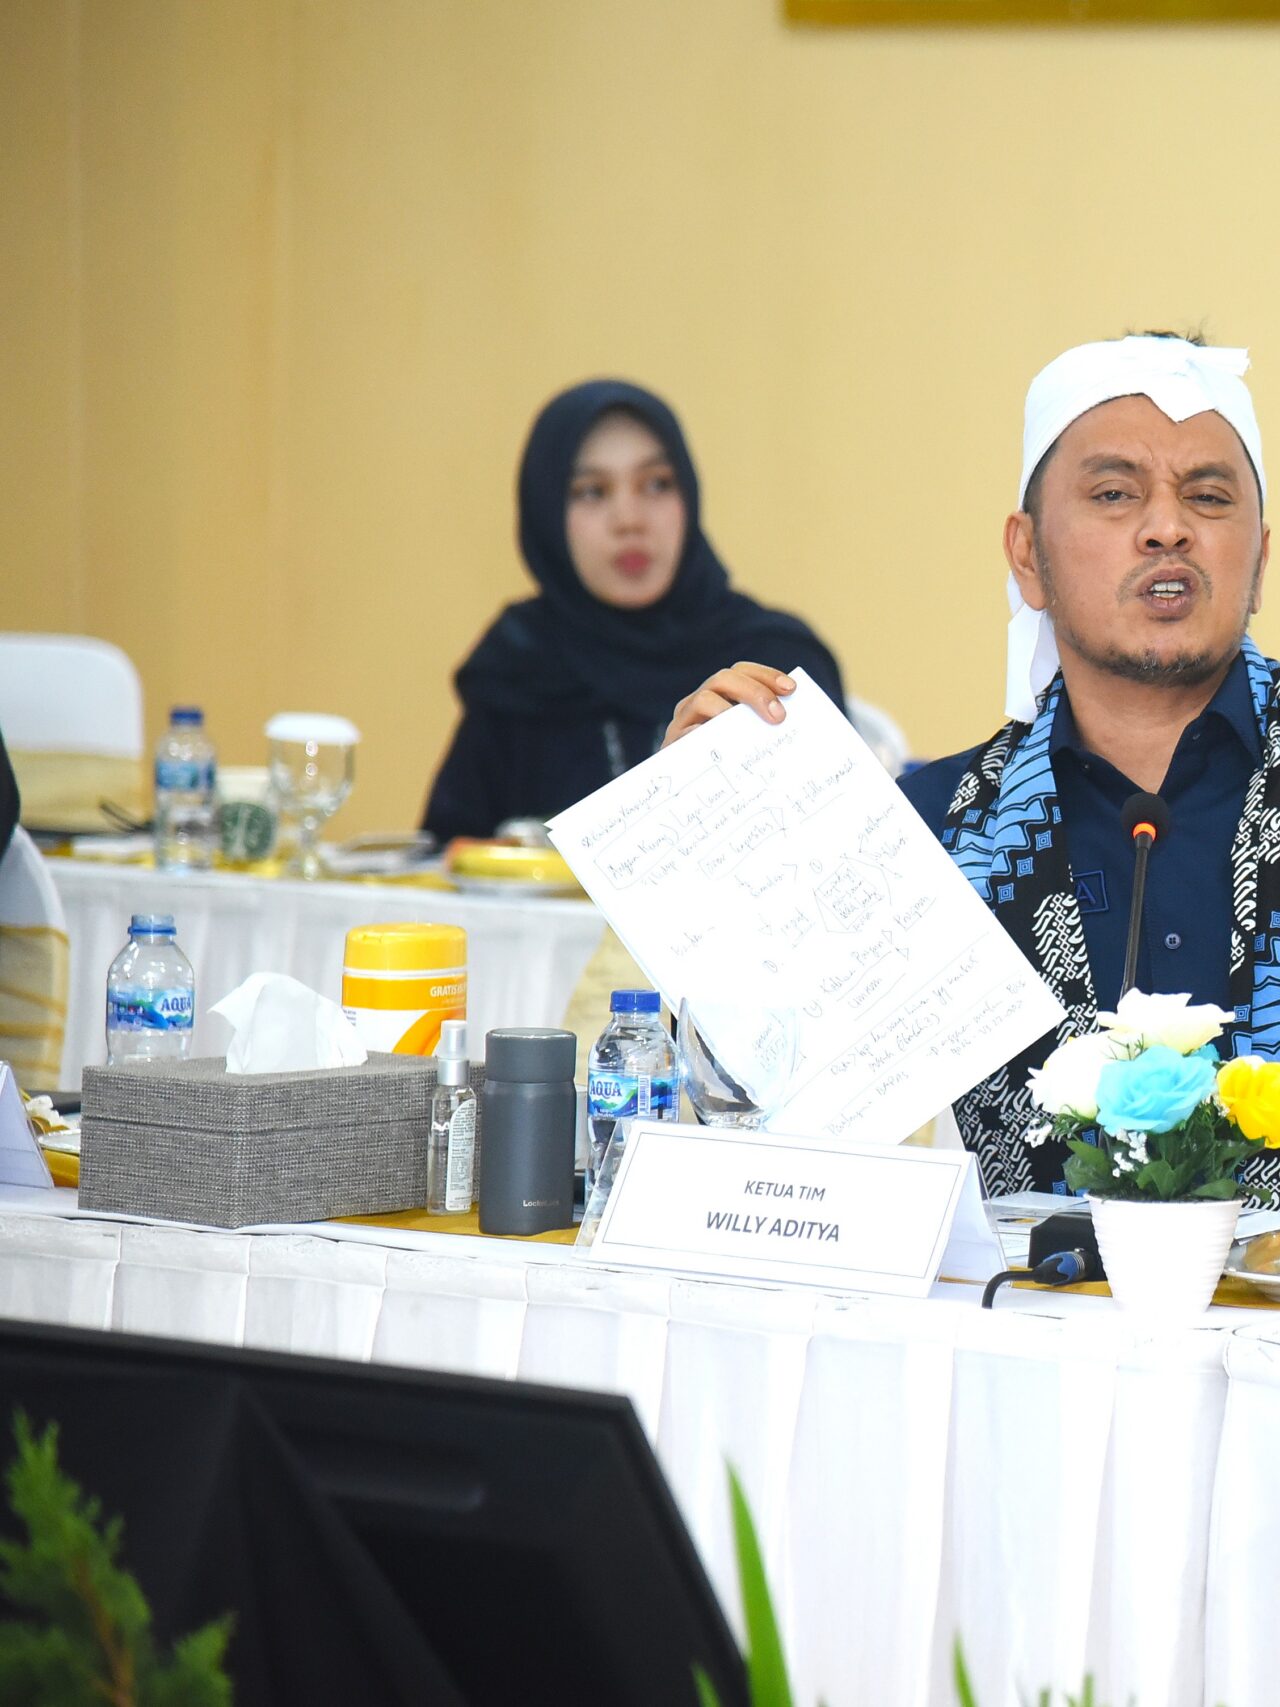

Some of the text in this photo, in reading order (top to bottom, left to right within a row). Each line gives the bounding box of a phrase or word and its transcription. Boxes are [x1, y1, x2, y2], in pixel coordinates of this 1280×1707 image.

[590, 1080, 622, 1099] AQUA
[744, 1180, 826, 1201] KETUA TIM
[706, 1211, 840, 1242] WILLY ADITYA
